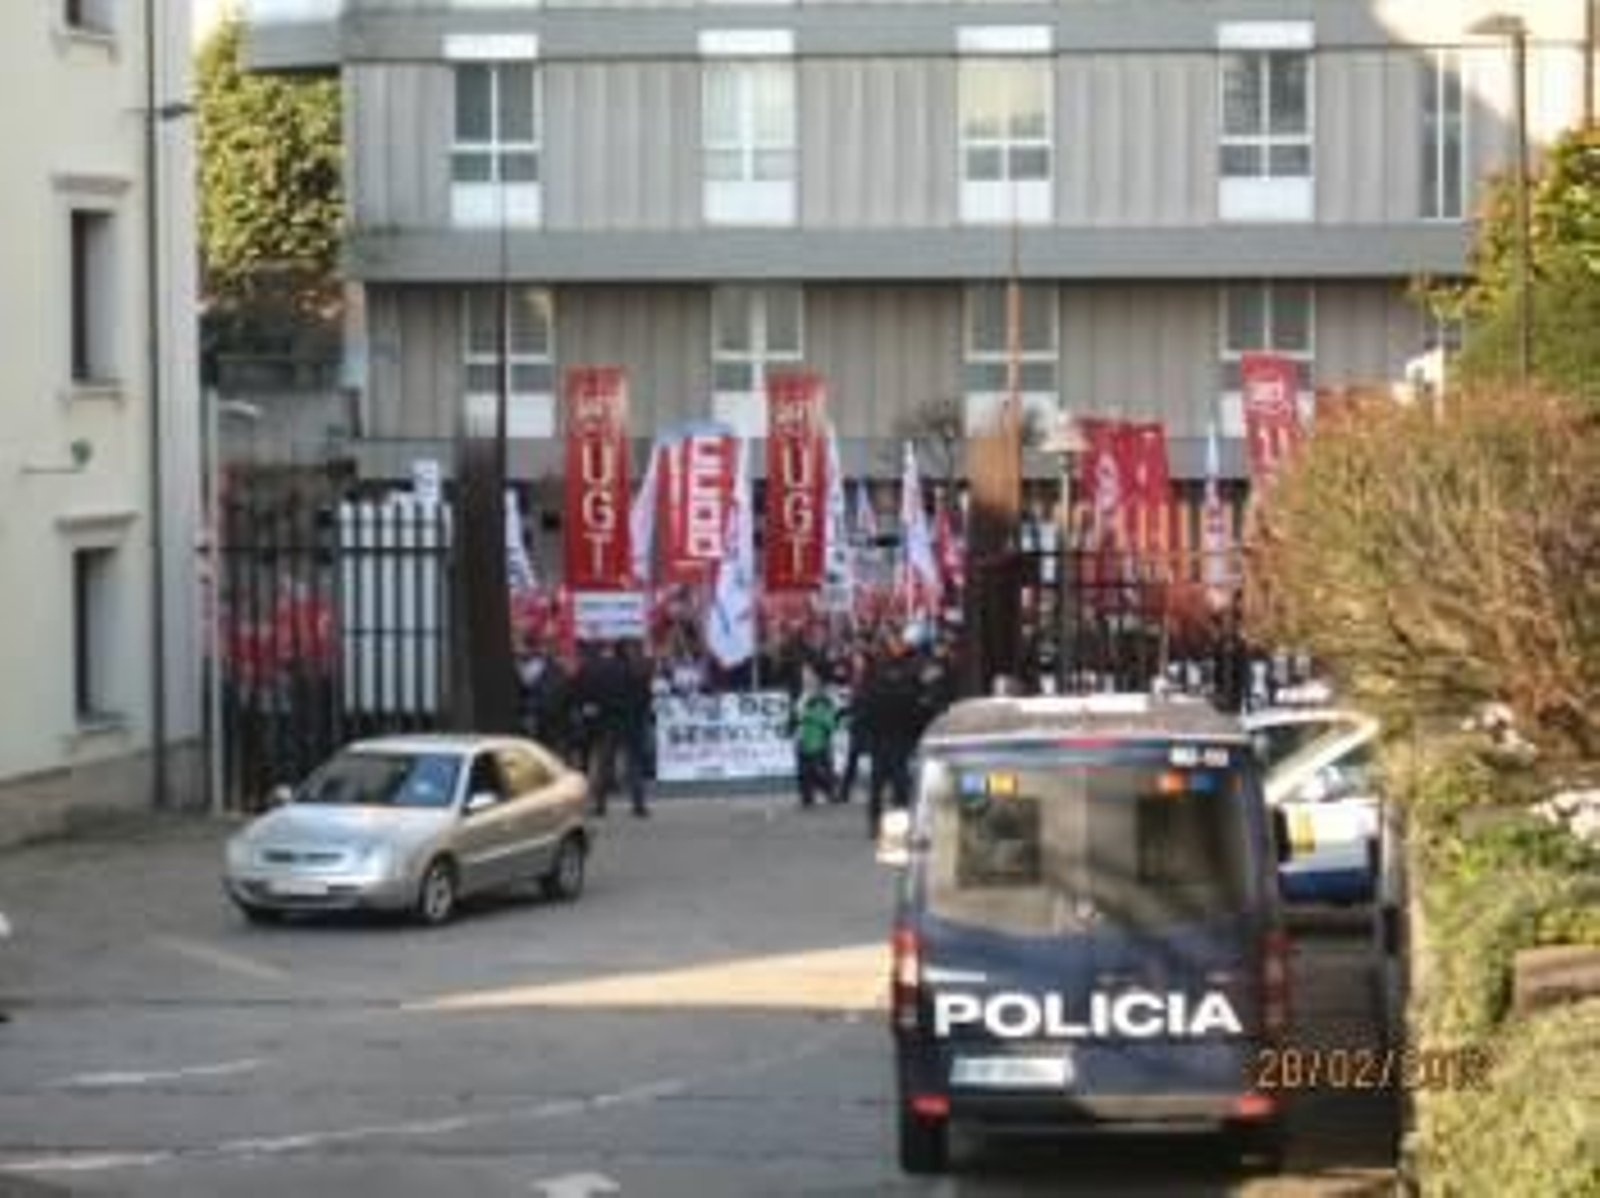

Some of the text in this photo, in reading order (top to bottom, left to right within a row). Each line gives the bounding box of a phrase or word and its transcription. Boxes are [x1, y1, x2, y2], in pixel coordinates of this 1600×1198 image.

[582, 442, 616, 581] UGT
[783, 440, 814, 582] UGT
[934, 990, 1243, 1037] POLICIA
